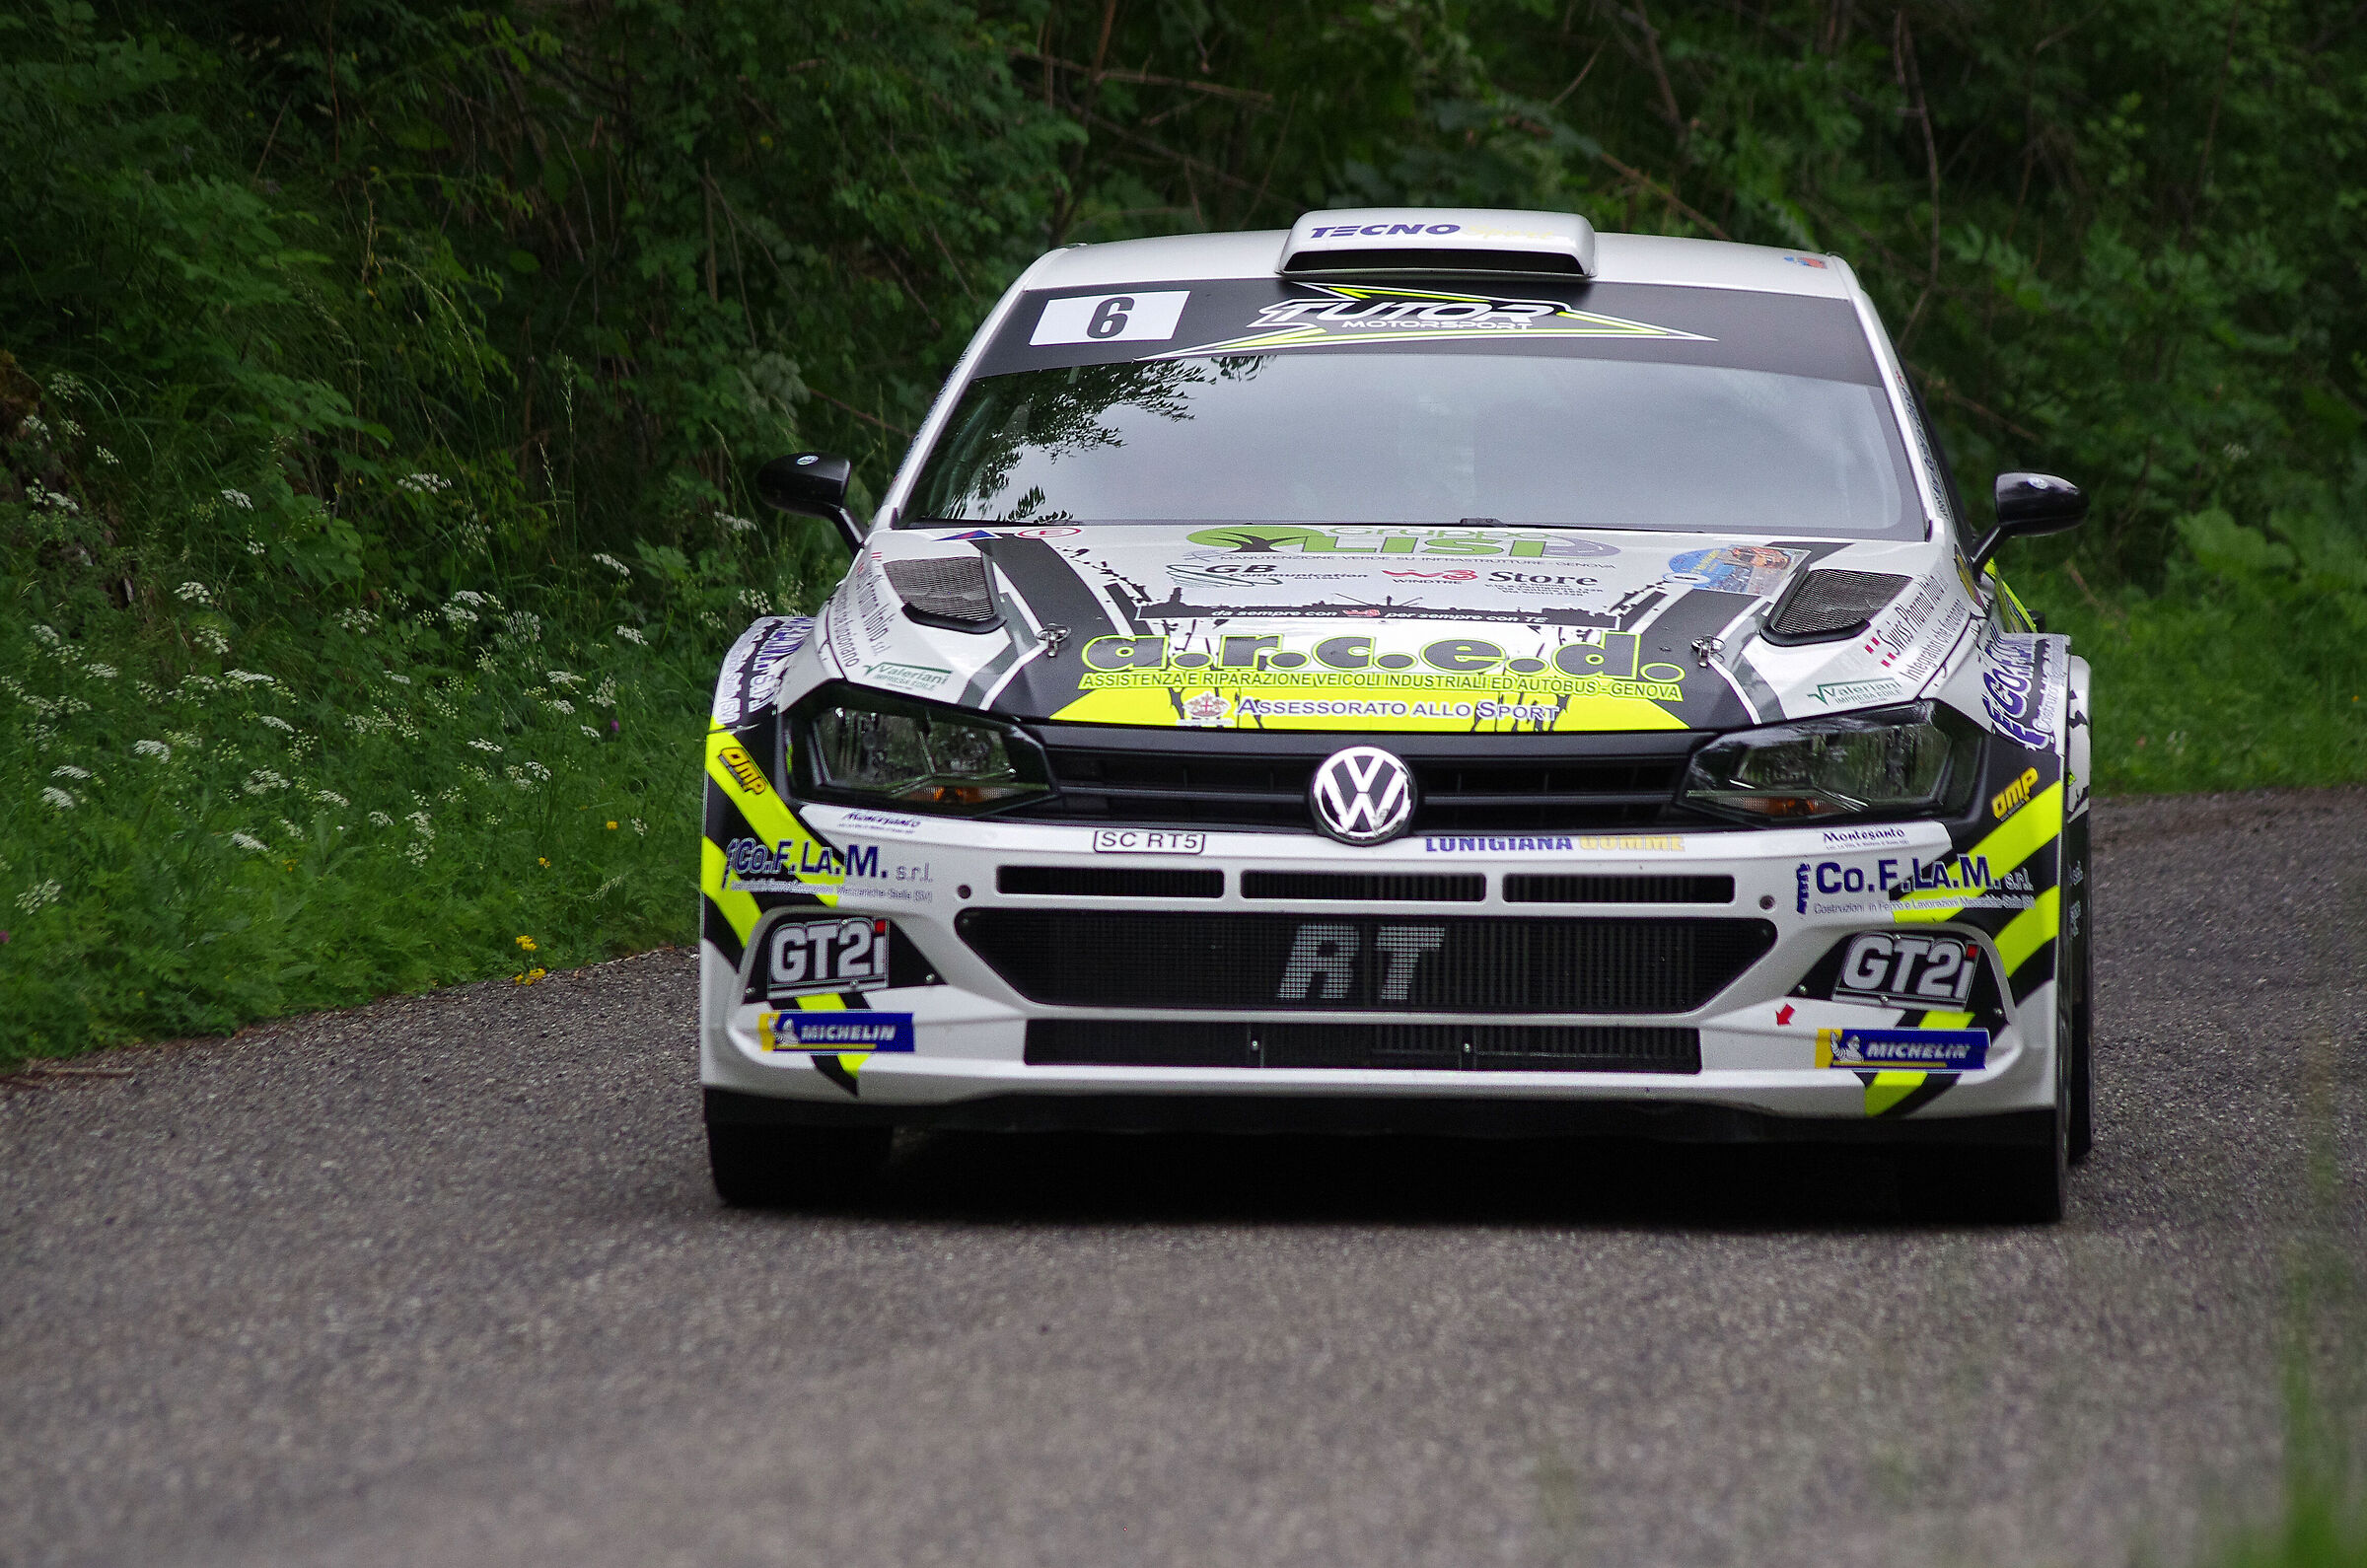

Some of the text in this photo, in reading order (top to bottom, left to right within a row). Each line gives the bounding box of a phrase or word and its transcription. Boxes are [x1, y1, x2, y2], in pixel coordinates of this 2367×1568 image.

[1310, 224, 1461, 240] TECNO
[1087, 297, 1135, 339] 6
[1266, 302, 1555, 322] TUTOR
[1341, 319, 1534, 330] MOTORSPORT
[1487, 571, 1598, 586] Store
[1417, 612, 1483, 621] sempre
[1894, 592, 1935, 633] Pharma
[1876, 620, 1914, 656] Swiss
[880, 665, 948, 684] Valeriani
[1083, 673, 1182, 685] ASSISTENZA
[1187, 673, 1198, 685] E
[1202, 673, 1314, 685] RIPARAZIONE
[1316, 673, 1381, 685] VEICOLI
[1385, 675, 1485, 688] INDUSTRIALI
[1491, 677, 1513, 689] ED
[1518, 677, 1596, 693] AUTOBUS
[1612, 682, 1681, 699] GENOVA
[1823, 680, 1902, 697] Valeriani
[1238, 698, 1559, 721] ASSESSORATO ALLO SPORT
[1102, 831, 1198, 849] SC RT5
[1425, 835, 1686, 852] LUNIGIANA GOMME
[1823, 826, 1905, 844] Montesanto
[1814, 901, 1865, 914] Costruzioni
[769, 919, 888, 983] GT2i
[1277, 923, 1447, 1002] RT
[1841, 934, 1978, 999] GT2i
[800, 1024, 897, 1041] MICHELIN
[1866, 1041, 1972, 1060] MICHELIN
